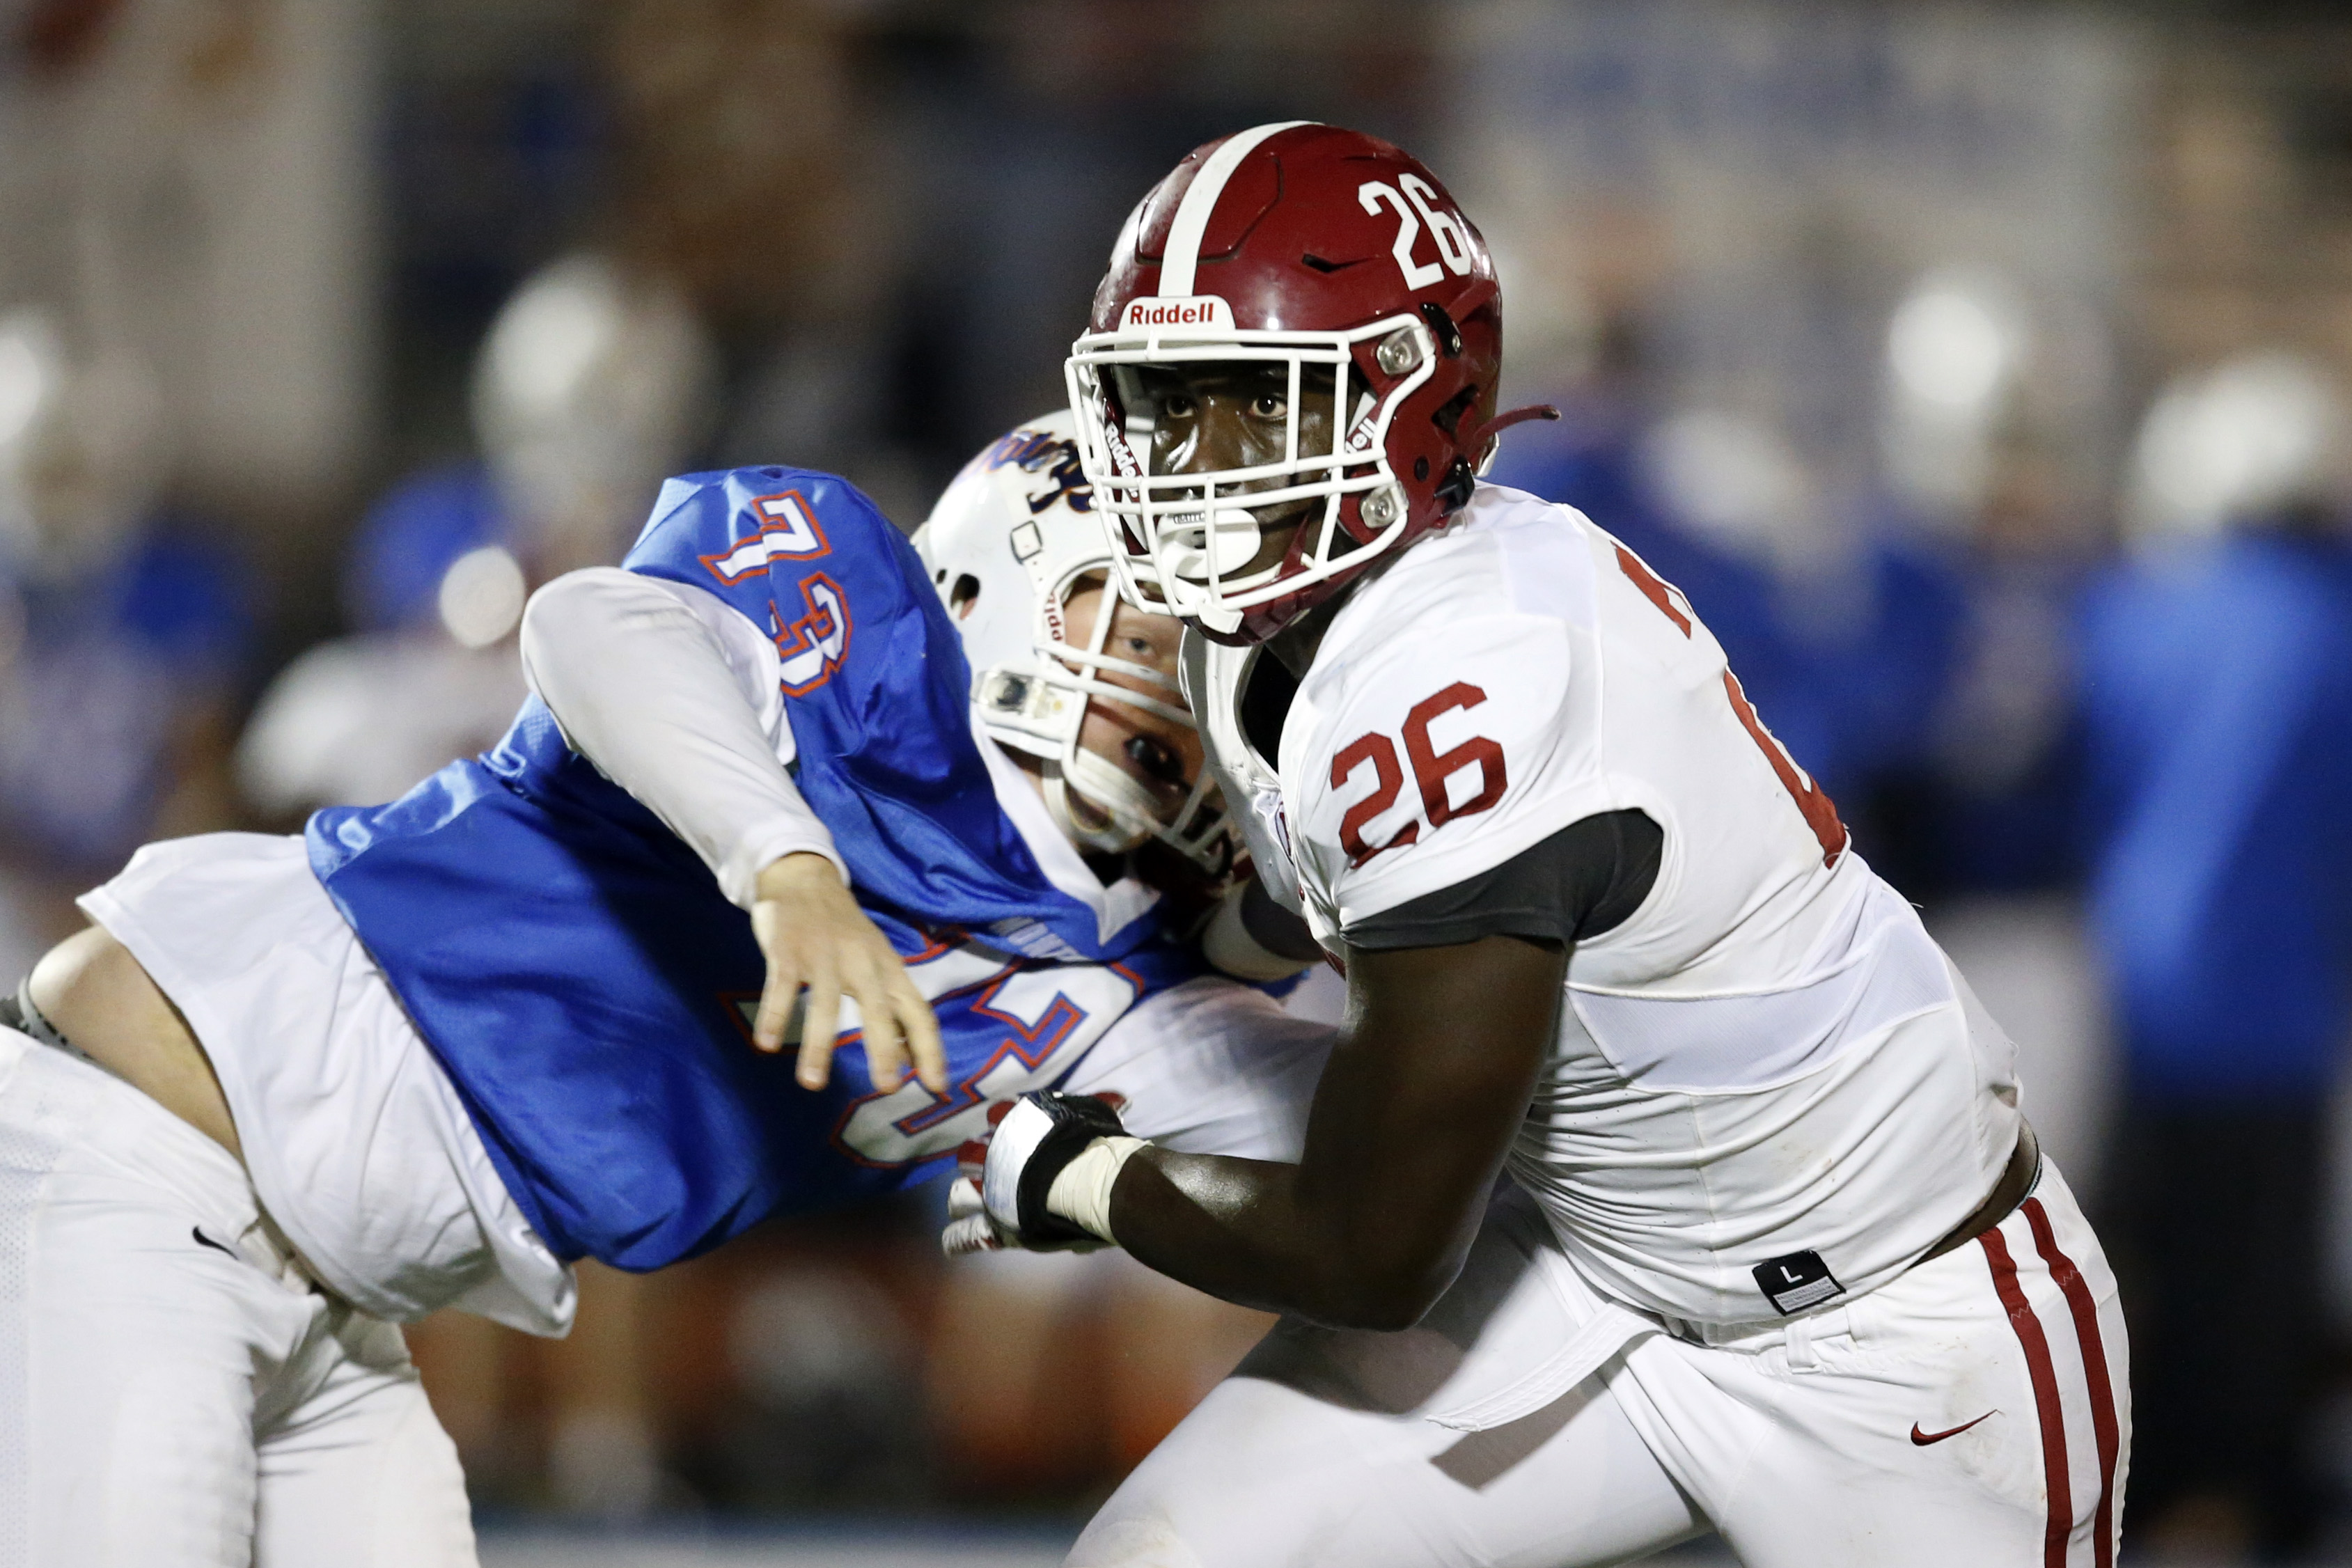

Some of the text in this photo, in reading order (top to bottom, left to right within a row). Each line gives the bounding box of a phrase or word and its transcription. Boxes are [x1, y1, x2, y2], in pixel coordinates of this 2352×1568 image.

[1358, 173, 1471, 291] 26
[1130, 303, 1214, 324] Riddell
[1105, 421, 1140, 498] Ridde
[698, 489, 853, 698] 73
[1330, 680, 1508, 869] 26
[1780, 1265, 1803, 1283] L
